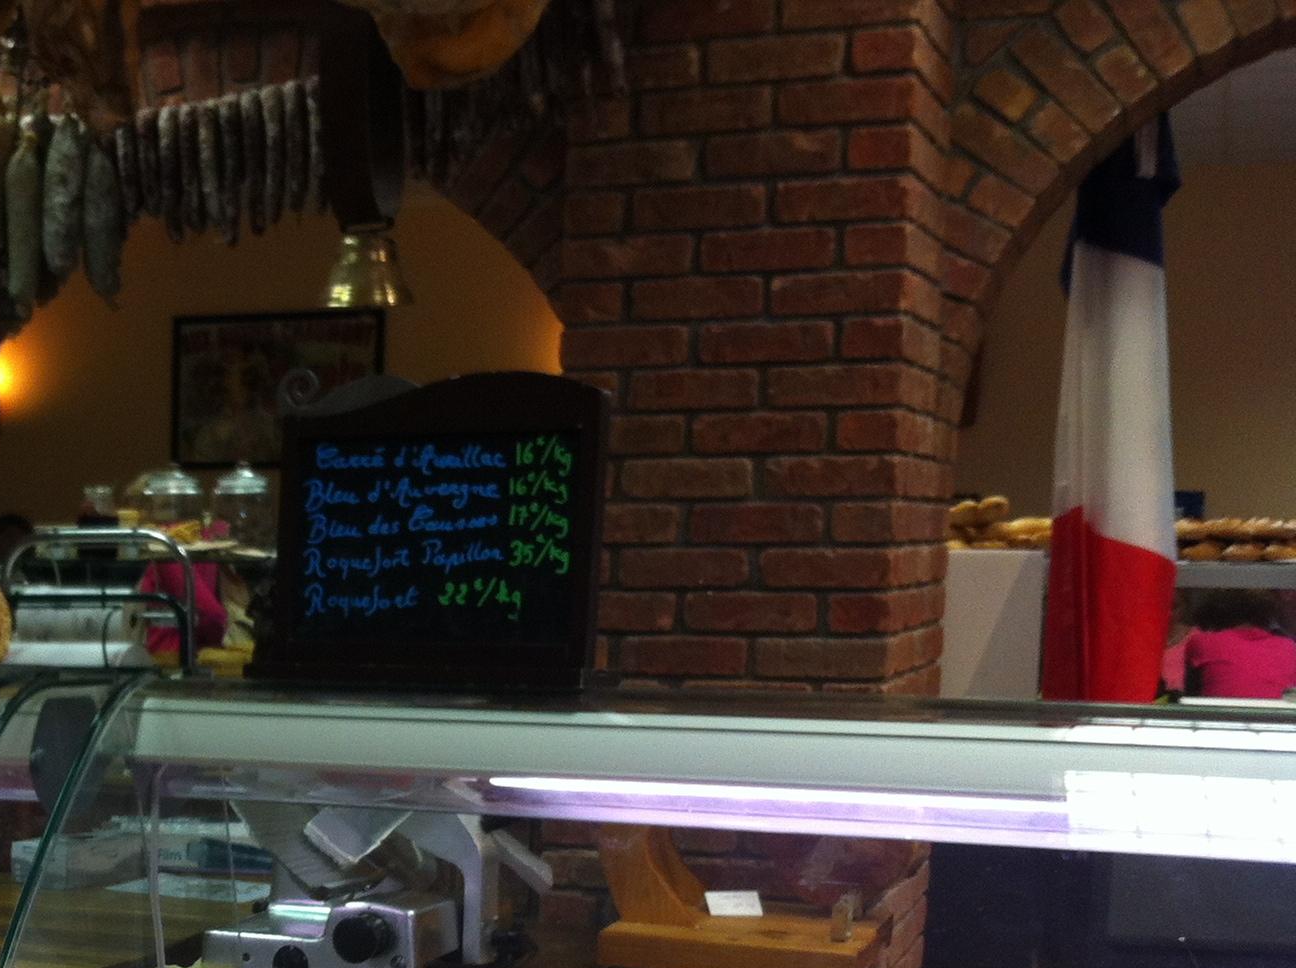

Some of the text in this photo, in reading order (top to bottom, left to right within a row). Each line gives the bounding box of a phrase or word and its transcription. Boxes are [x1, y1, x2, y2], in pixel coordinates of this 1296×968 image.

[305, 480, 360, 513] Bleu
[307, 514, 363, 544] Bleu
[368, 515, 400, 535] des
[304, 547, 410, 580] Roquefort
[422, 538, 504, 573] Papillon
[305, 582, 419, 617] Roquefort
